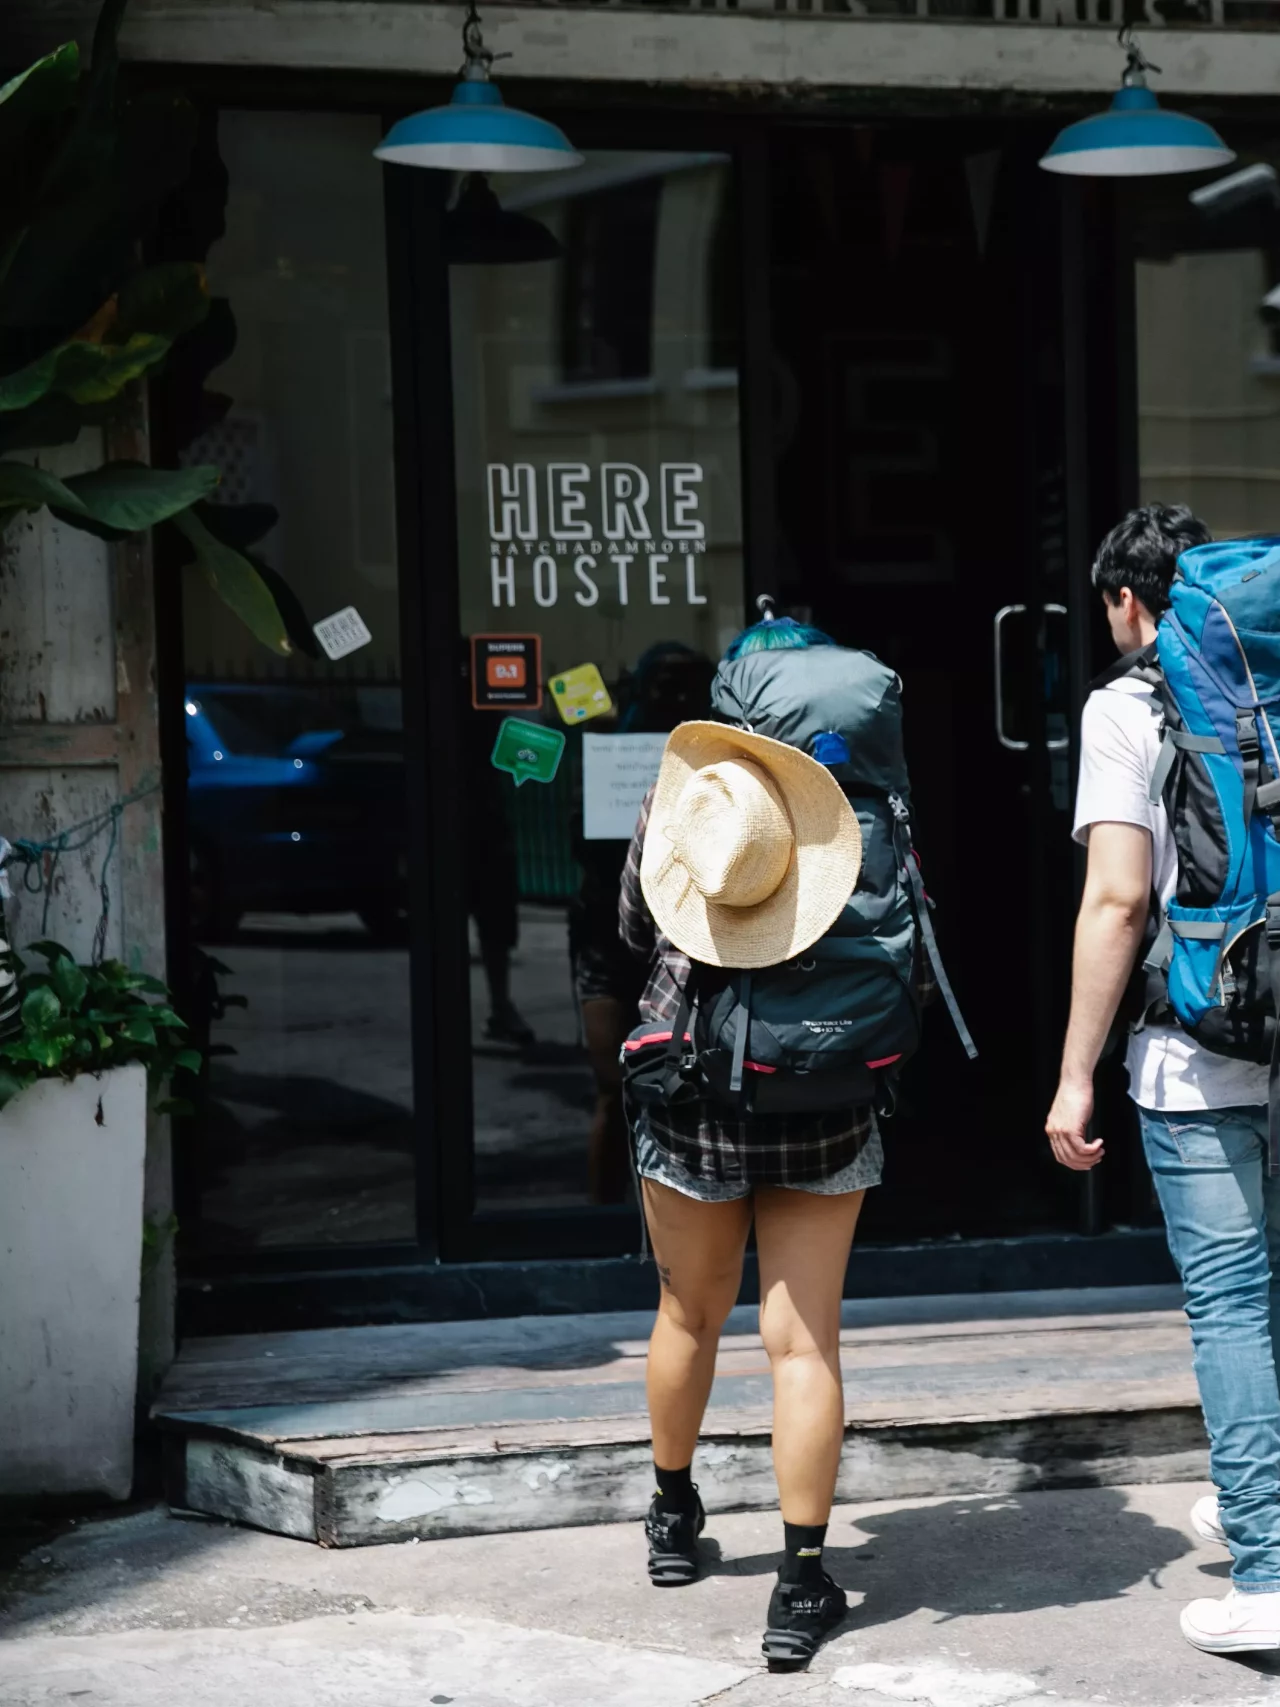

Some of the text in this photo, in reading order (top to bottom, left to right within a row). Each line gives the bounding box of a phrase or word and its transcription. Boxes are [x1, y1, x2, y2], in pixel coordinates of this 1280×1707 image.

[487, 462, 706, 541] HERE
[490, 541, 706, 555] RATCHADAMNOEN
[491, 554, 707, 607] HOSTEL
